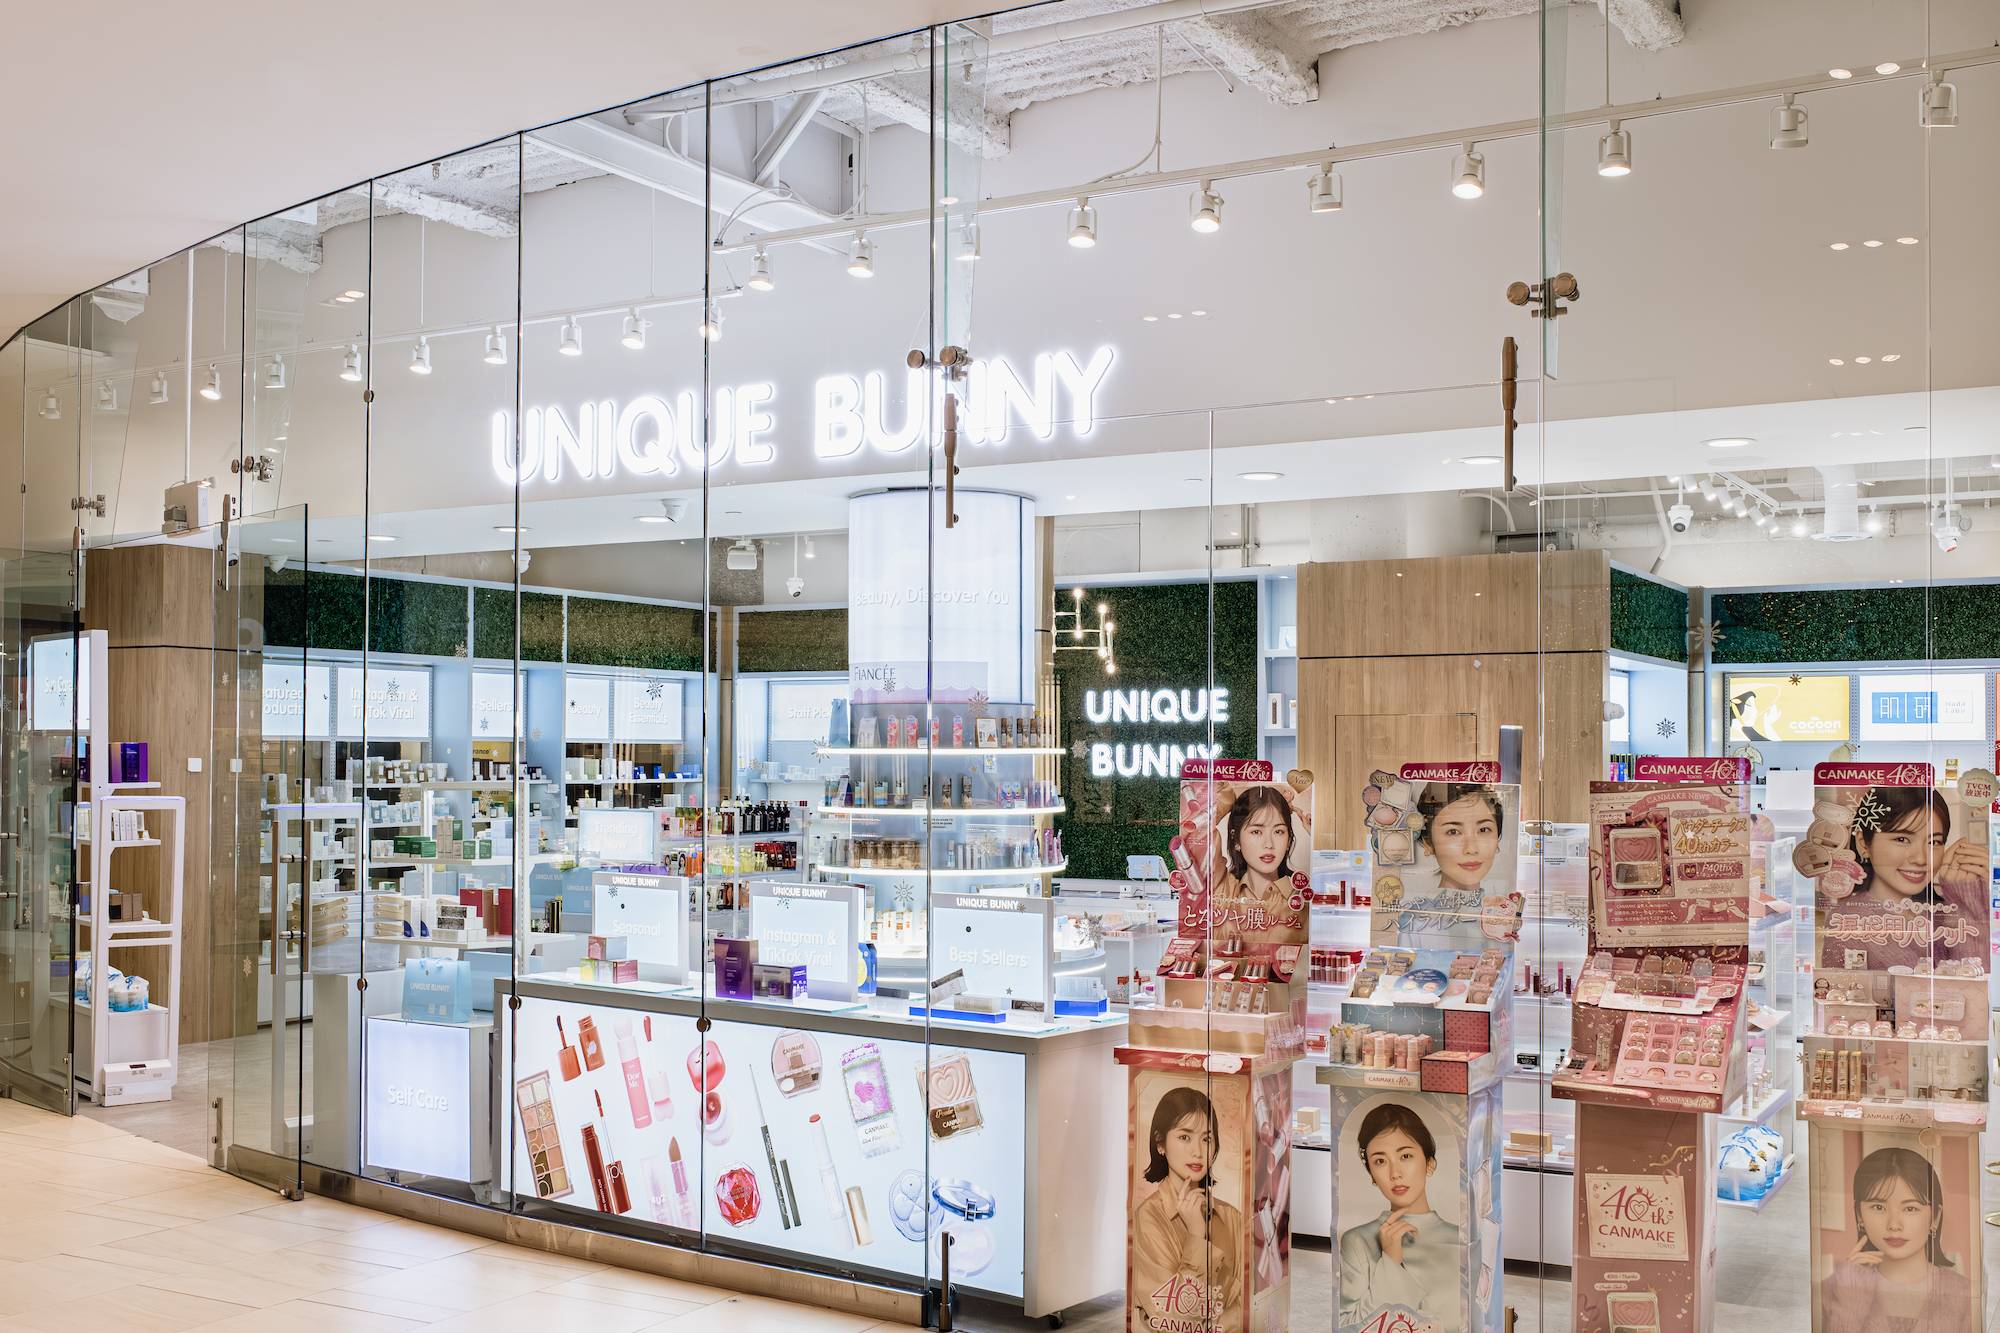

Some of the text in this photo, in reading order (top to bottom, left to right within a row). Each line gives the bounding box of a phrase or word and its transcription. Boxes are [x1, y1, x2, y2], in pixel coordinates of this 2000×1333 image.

[491, 345, 1115, 484] UNIQUE BUNNY
[983, 588, 1010, 606] You
[1085, 688, 1230, 723] UNIQUE
[1789, 720, 1841, 730] cocoon
[1403, 768, 1459, 779] CANMAKE
[1639, 763, 1702, 775] CANMAKE
[1817, 768, 1885, 780] CANMAKE
[1966, 782, 1992, 791] TVCM
[612, 876, 660, 887] UNIQUE BUNNY
[801, 887, 828, 898] BUNNY
[956, 897, 1020, 910] UNIQUE BUNNY
[763, 928, 840, 947] Instagram &
[765, 947, 832, 968] TikTok Viral
[950, 946, 1028, 967] Best Sellers
[388, 1084, 449, 1111] Self Care
[1599, 1184, 1674, 1226] 40th
[1598, 1224, 1676, 1244] CANMAKE
